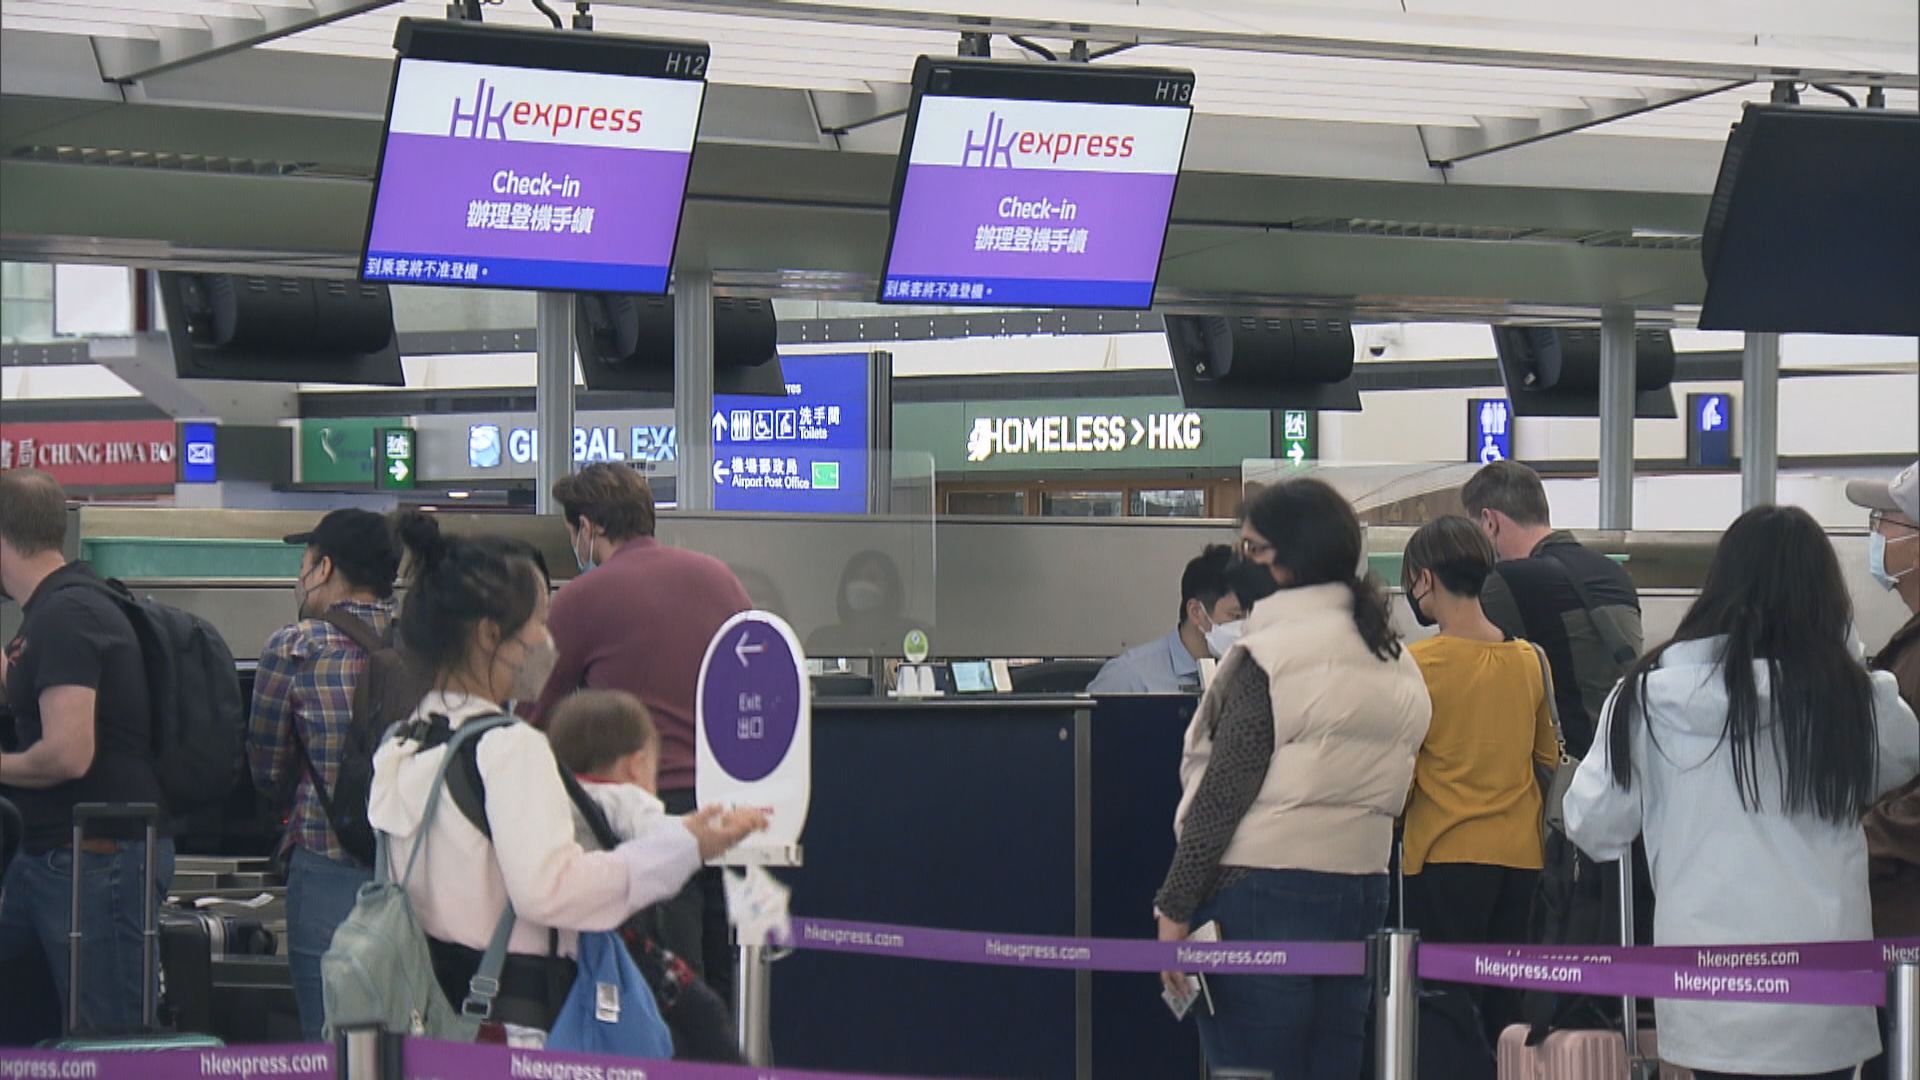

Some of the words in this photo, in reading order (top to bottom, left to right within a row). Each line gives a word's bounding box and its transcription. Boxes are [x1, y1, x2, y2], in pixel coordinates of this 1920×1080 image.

[665, 52, 706, 76] H12
[1154, 80, 1192, 102] H13
[492, 170, 581, 198] Check-in
[466, 200, 594, 235] 辦理登機手續
[998, 196, 1077, 220] Check-in
[974, 224, 1089, 254] 辦理登機手續
[800, 405, 840, 425] 洗手間
[799, 425, 828, 440] Toilets
[982, 415, 1126, 453] HOMELESS
[1148, 413, 1201, 450] HKG
[38, 443, 101, 465] CHUNG
[105, 442, 147, 464] HWA
[732, 474, 763, 489] Airport
[764, 475, 783, 488] Post
[784, 475, 810, 489] Office
[738, 692, 763, 712] Exit
[737, 716, 764, 739] 出口
[804, 923, 904, 948] hkexpress.com
[985, 939, 1091, 961] hkexpress.com
[1176, 946, 1288, 968] hkexpress.com
[1697, 950, 1801, 968] hkexpress.com
[1475, 955, 1582, 983] hkexpress.com
[1674, 971, 1790, 995] hkexpress.com
[0, 1058, 97, 1079] xpress.com
[200, 1052, 329, 1078] hkexpress.com
